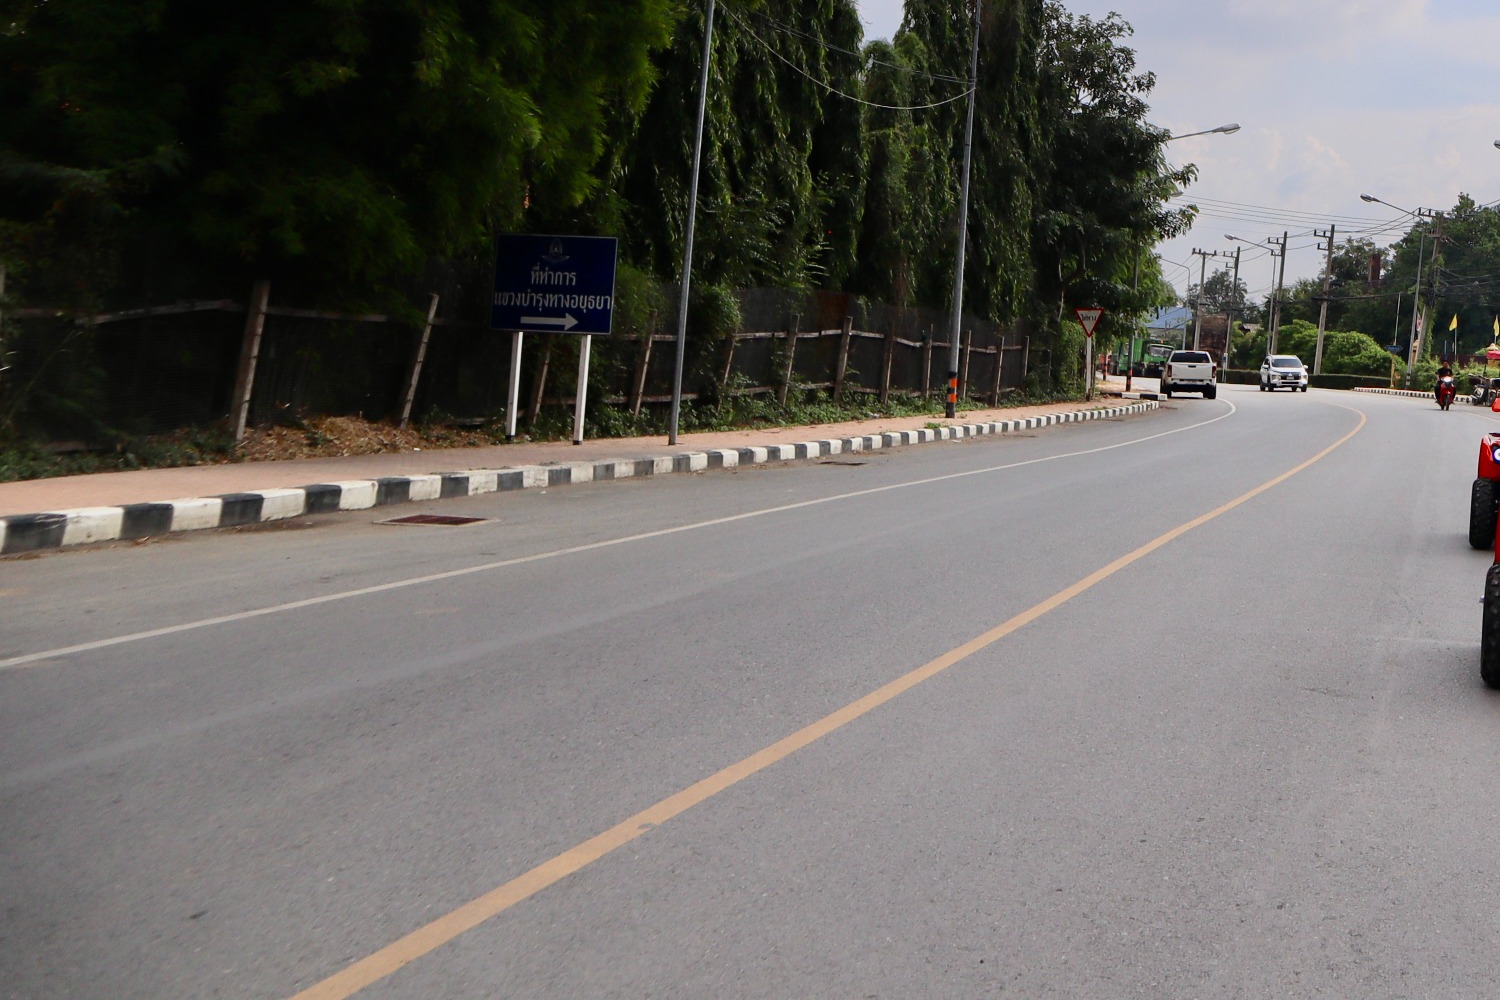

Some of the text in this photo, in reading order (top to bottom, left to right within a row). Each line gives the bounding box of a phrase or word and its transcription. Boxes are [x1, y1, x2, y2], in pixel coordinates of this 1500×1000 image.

[531, 262, 577, 286] ที่ทำการ
[494, 289, 611, 313] แขวงบำรุงทางอยุธยา
